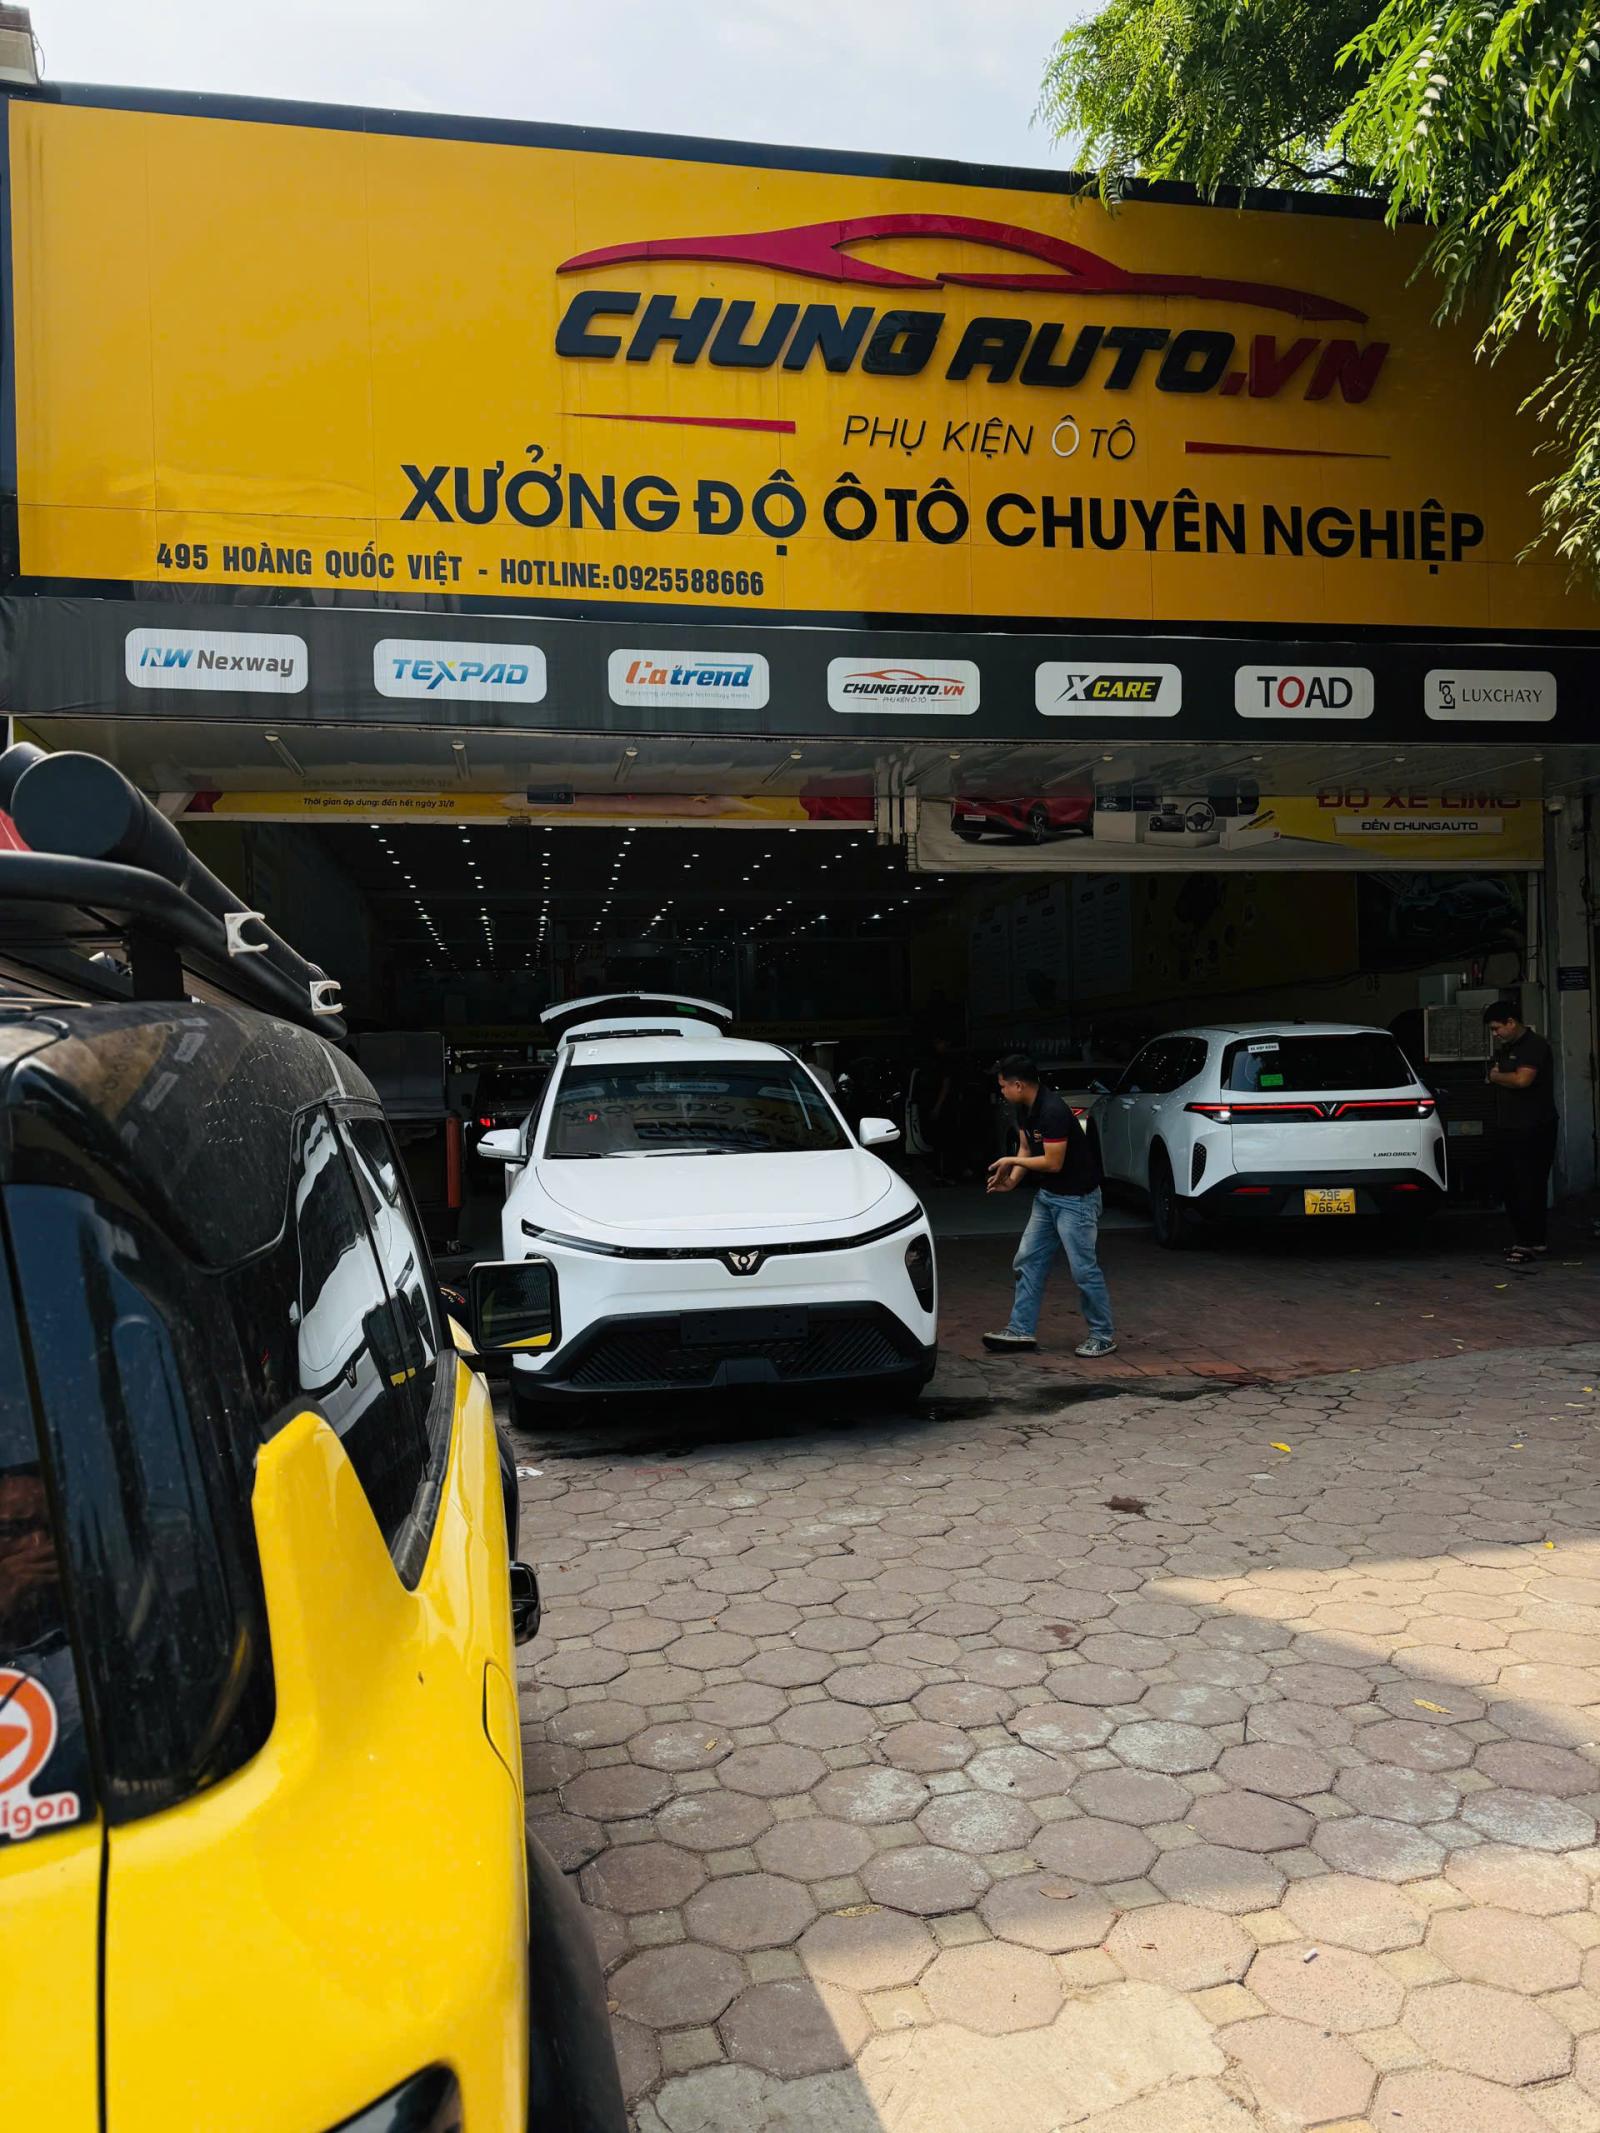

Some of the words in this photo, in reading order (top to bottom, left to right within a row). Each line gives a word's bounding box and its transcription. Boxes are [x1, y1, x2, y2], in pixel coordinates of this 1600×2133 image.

[555, 290, 946, 376] CHUNG
[945, 317, 1391, 403] AUTO.VN
[843, 415, 926, 456] PHỤ
[943, 416, 1034, 459] KIỆN
[1051, 414, 1081, 457] Ô
[1091, 418, 1136, 460] TÔ
[400, 444, 680, 532] XƯỞNG
[693, 469, 807, 556] ĐỘ
[986, 488, 1245, 554] CHUYÊN
[1264, 498, 1484, 575] NGHIỆP
[157, 543, 208, 570] 495
[223, 542, 312, 575] HOÀNG
[325, 540, 394, 578] QUỐC
[408, 551, 462, 585] VIỆT
[197, 649, 295, 678] Nexway
[392, 659, 529, 690] TEXPAD
[843, 683, 965, 697] CHUNGAUTO.VN
[1257, 676, 1353, 708] TOAD
[1462, 688, 1543, 702] LUXCHARY
[323, 798, 341, 808] gian
[415, 799, 436, 810] ngày
[1394, 822, 1478, 831] CHUNGAUTO
[1311, 1201, 1350, 1214] 766.45
[1319, 1190, 1341, 1201] 29E
